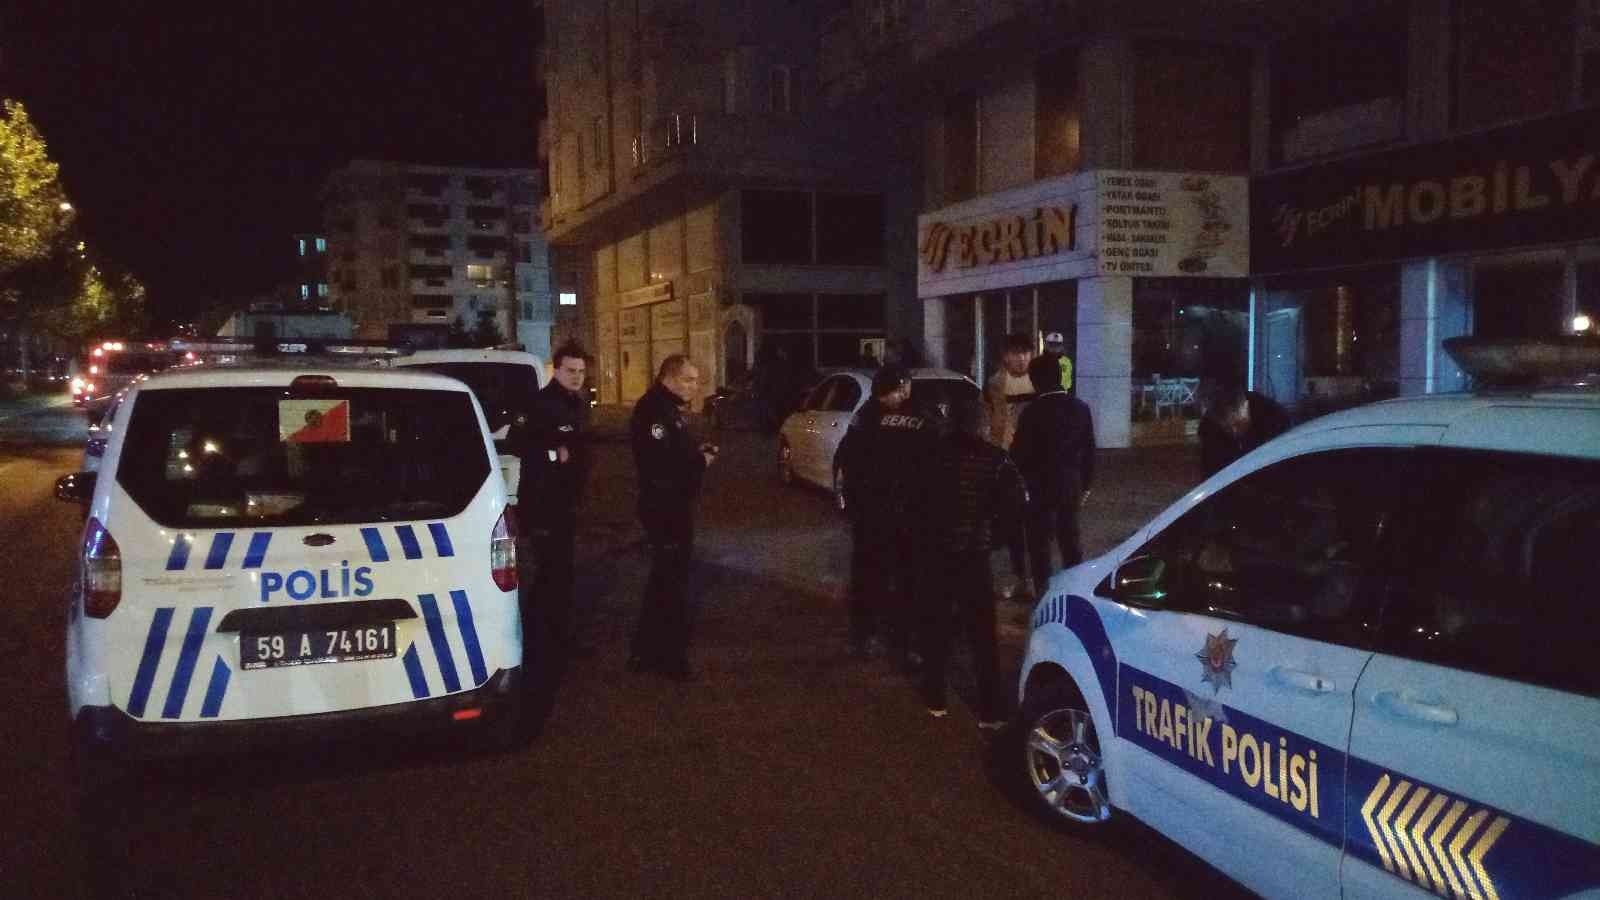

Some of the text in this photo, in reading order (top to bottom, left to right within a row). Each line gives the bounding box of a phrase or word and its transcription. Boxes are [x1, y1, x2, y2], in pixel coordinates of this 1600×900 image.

[1361, 155, 1600, 231] MOBİLY
[954, 204, 1077, 267] ECRİN
[1106, 261, 1118, 271] TV
[261, 560, 373, 601] POLİS
[257, 628, 389, 660] 59 A 74161
[1221, 724, 1320, 819] POLİSİ
